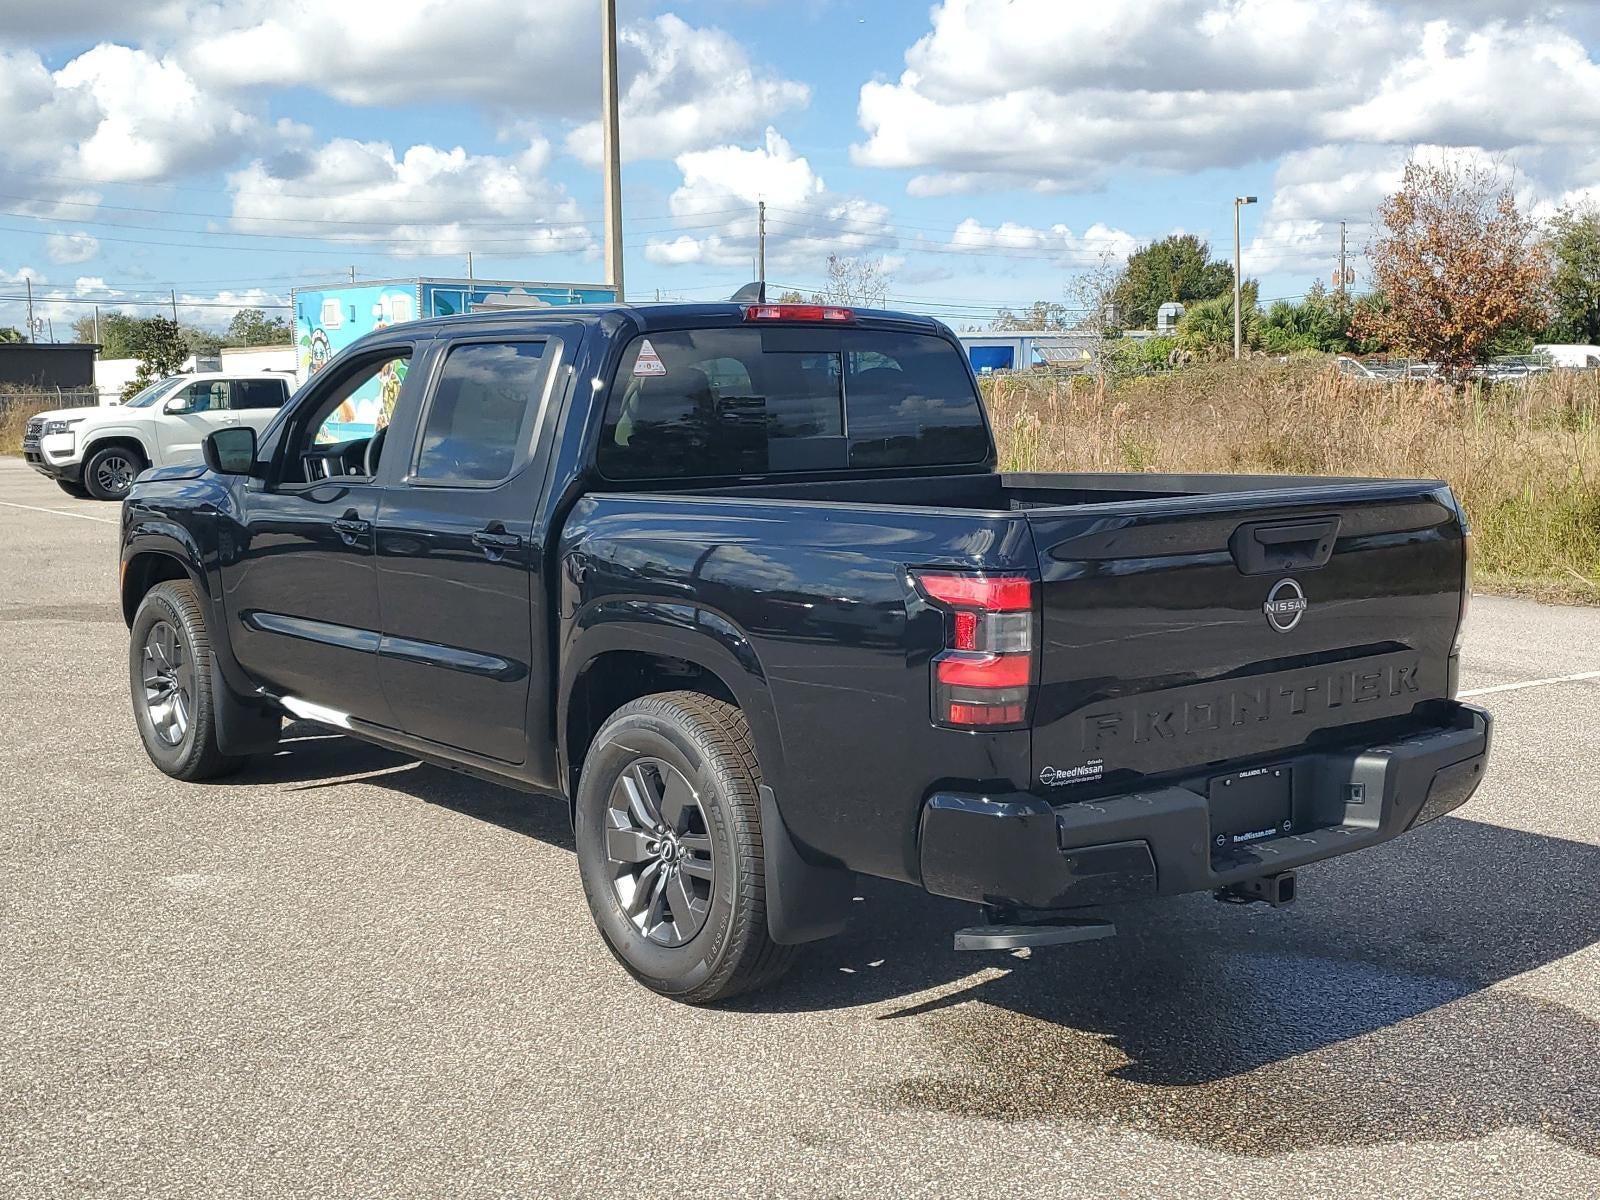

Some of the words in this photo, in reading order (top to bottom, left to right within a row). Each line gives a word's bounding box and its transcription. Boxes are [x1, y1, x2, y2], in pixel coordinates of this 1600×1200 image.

[1266, 600, 1307, 612] NISSAN
[1081, 661, 1420, 754] FRONTIER
[1233, 828, 1276, 843] ReedNissan.com
